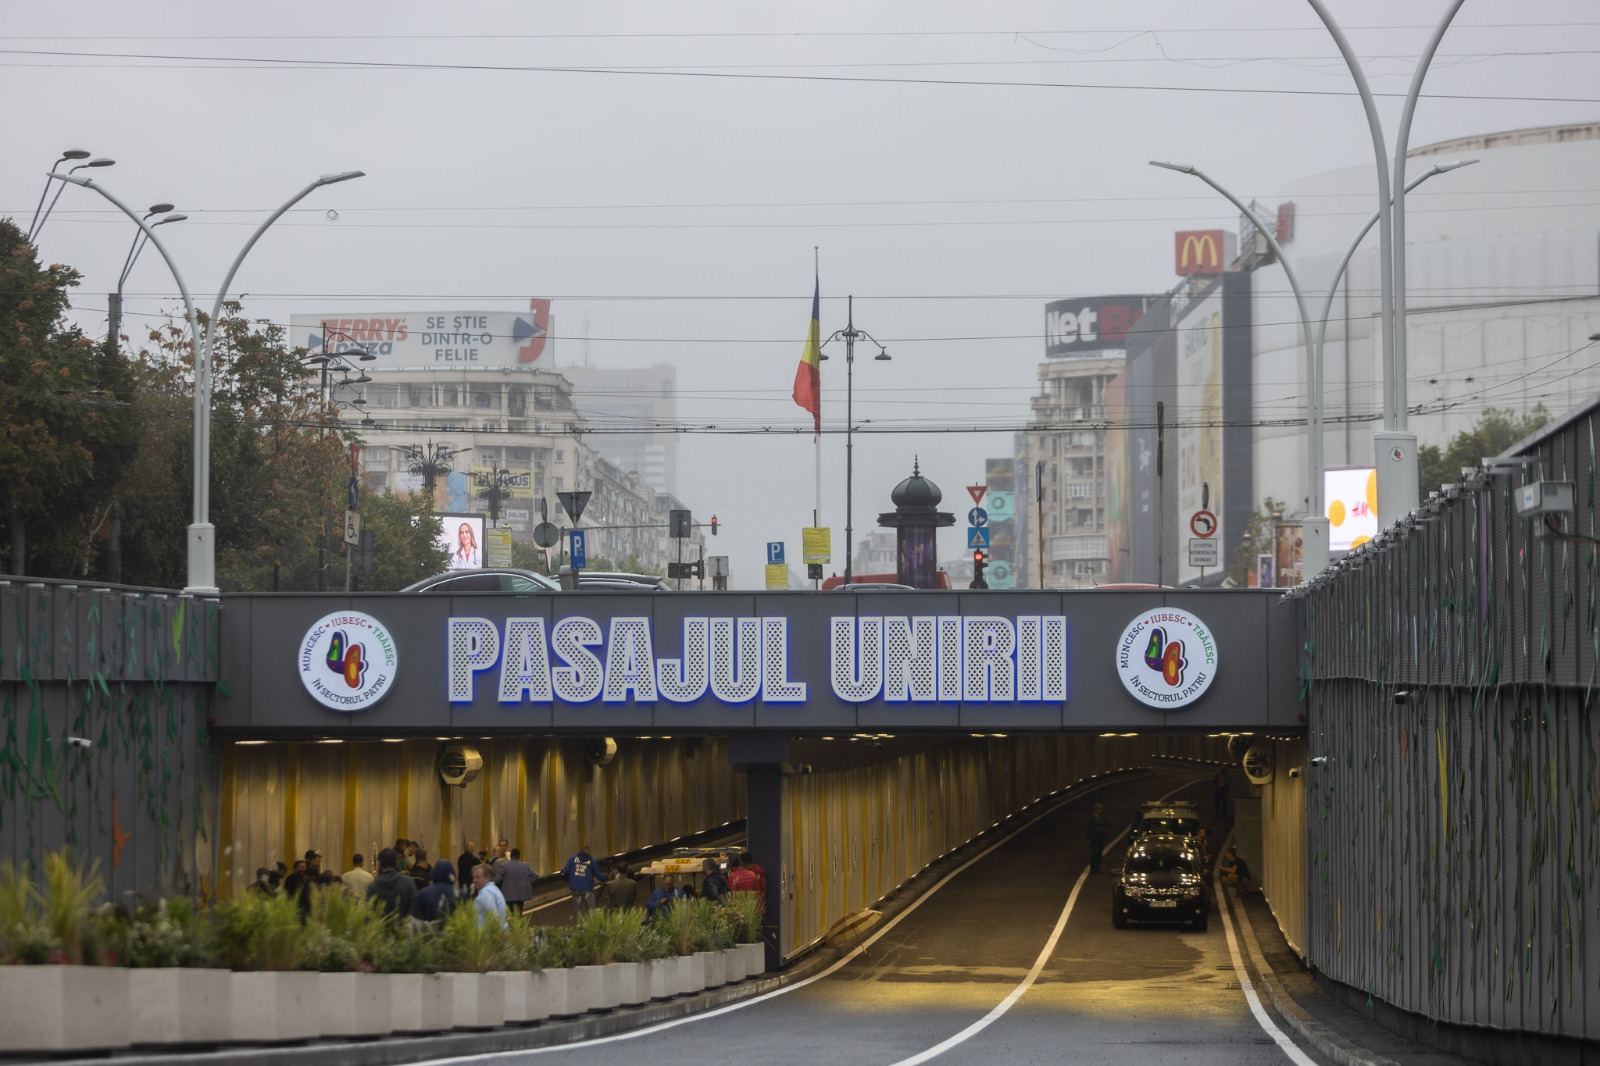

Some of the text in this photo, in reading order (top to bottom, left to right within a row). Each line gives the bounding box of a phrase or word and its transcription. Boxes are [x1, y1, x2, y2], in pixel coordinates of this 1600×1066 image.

[426, 316, 445, 329] SE
[421, 332, 493, 346] DINTR-O
[435, 348, 478, 361] FELIE
[574, 535, 582, 556] P
[771, 543, 781, 561] P
[303, 626, 326, 671] MUNCESC
[331, 616, 367, 627] IUBESC
[1121, 622, 1145, 668] MUNCESC
[1150, 613, 1187, 624] IUBESC
[448, 615, 1067, 703] PASAJUL UNIRII
[312, 674, 387, 704] ÎN SECTORUL PATRU
[1130, 672, 1206, 702] ÎN SECTORUL PATRU
